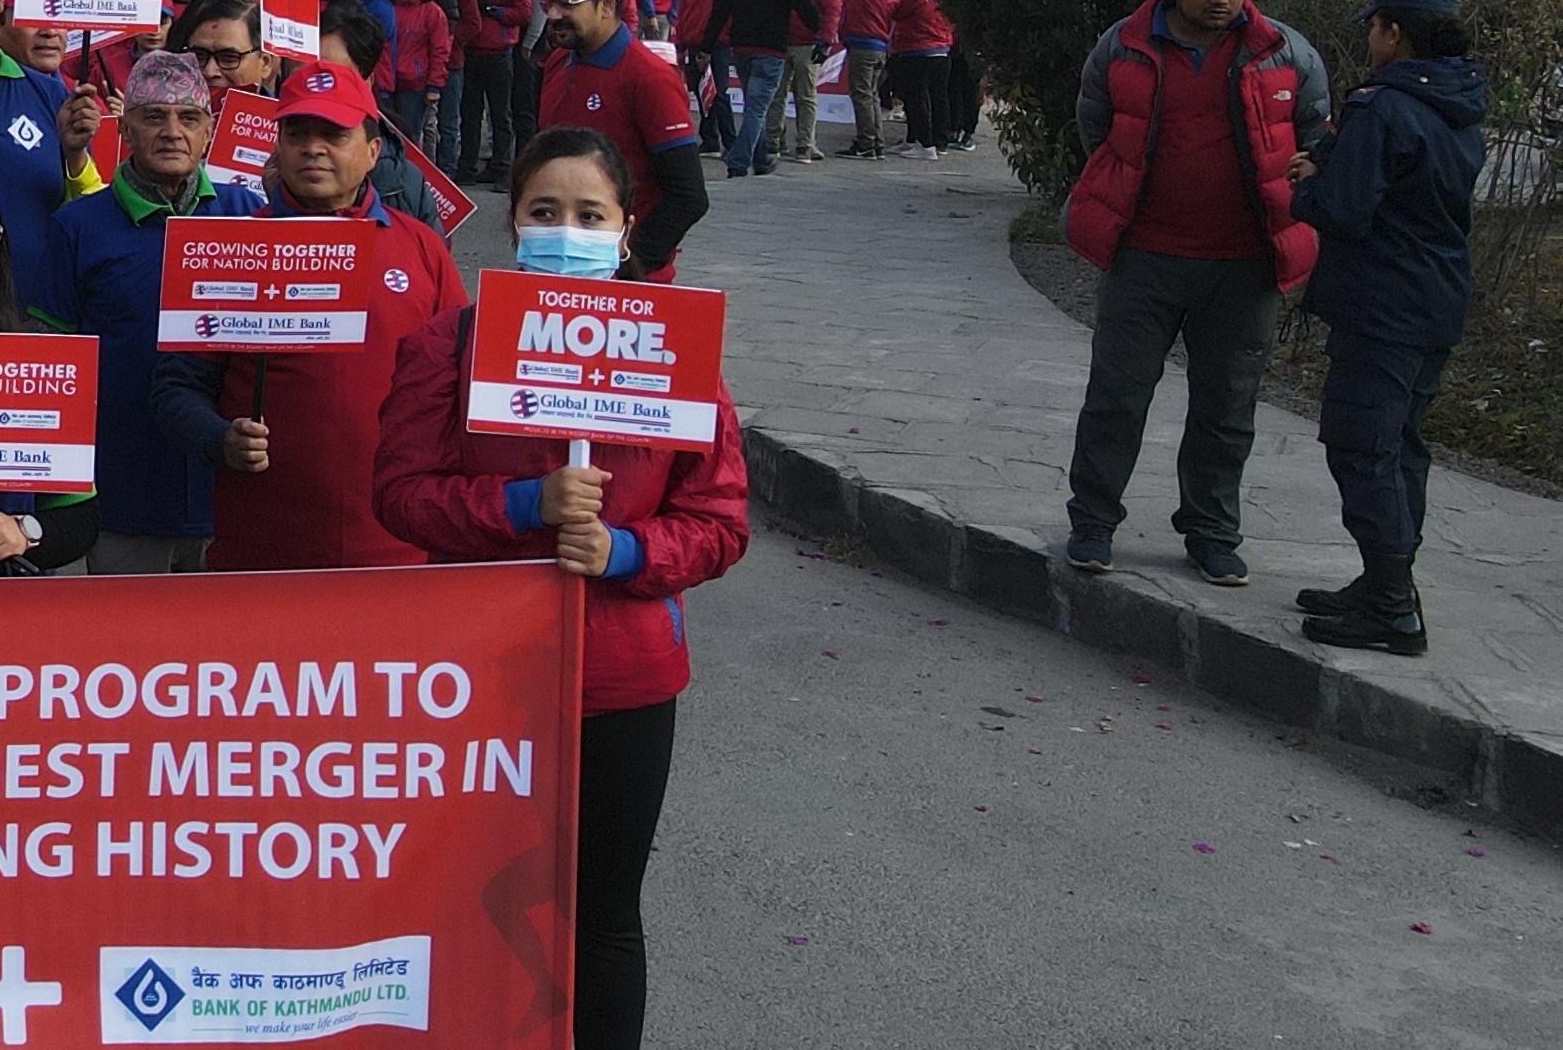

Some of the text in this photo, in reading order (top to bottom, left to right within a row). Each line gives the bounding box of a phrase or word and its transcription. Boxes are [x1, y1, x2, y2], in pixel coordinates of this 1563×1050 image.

[62, 0, 138, 12] Global IME Bank
[230, 124, 278, 143] FOR NATI
[183, 241, 356, 258] GROWING TOGETHER
[182, 257, 356, 272] FOR NATION BUILDING
[537, 290, 654, 316] TOGETHER FOR
[221, 316, 332, 330] Global IME Bank
[517, 310, 677, 366] MORE.
[540, 394, 587, 411] Global
[594, 398, 627, 414] IME
[632, 402, 672, 419] Bank
[14, 450, 52, 464] Bank
[374, 661, 472, 719] TO
[148, 741, 446, 798] MERGER
[461, 738, 534, 797] IN
[96, 821, 407, 880] HISTORY
[192, 966, 222, 989] बैंक
[229, 972, 266, 990] अफ
[353, 956, 410, 982] लिमिटेड
[192, 984, 410, 1016] BANK OF KATHMANDU LTD.
[245, 1024, 260, 1034] we
[262, 1020, 290, 1034] make
[291, 1022, 316, 1037] your
[317, 1016, 332, 1030] life
